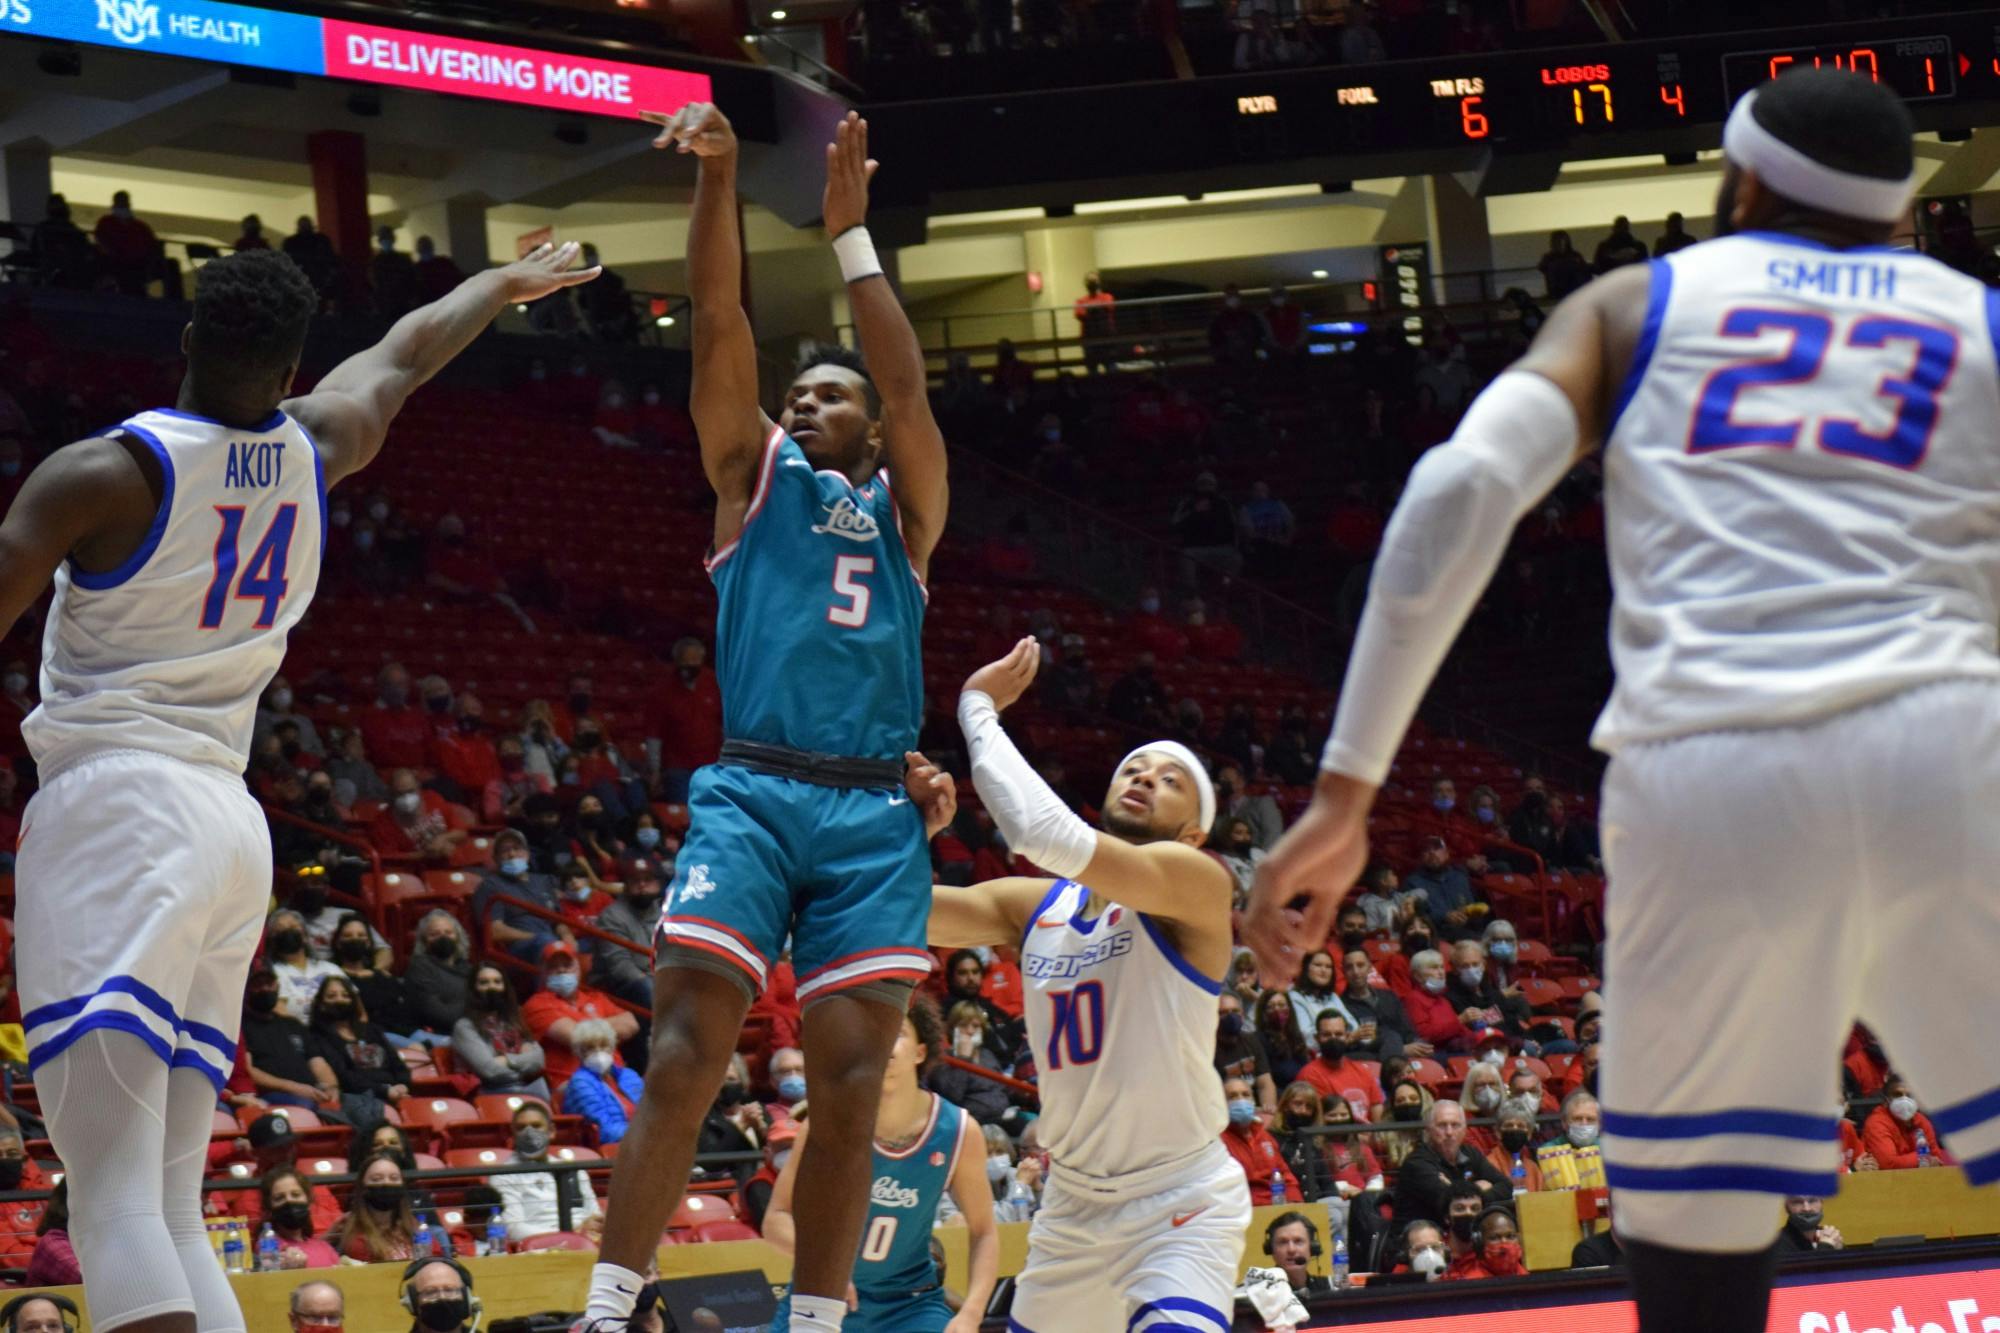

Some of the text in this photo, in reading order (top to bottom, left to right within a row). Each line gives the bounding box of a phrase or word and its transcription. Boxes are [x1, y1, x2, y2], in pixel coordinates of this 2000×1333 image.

[168, 13, 260, 47] HEALTH
[347, 34, 634, 104] DELIVERING MORE
[1430, 77, 1485, 97] TM FLS
[1541, 64, 1610, 85] LOBOS
[1237, 95, 1278, 114] PLYR
[1337, 86, 1379, 105] FOUL
[1573, 84, 1613, 124] 17
[1661, 85, 1684, 116] 4
[1461, 96, 1489, 138] 6
[1767, 259, 1897, 298] SMITH
[1684, 308, 1960, 472] 23
[225, 443, 286, 488] AKOT
[198, 502, 299, 630] 14
[827, 554, 875, 628] 5
[1046, 979, 1105, 1072] 10
[862, 1216, 898, 1261] 0
